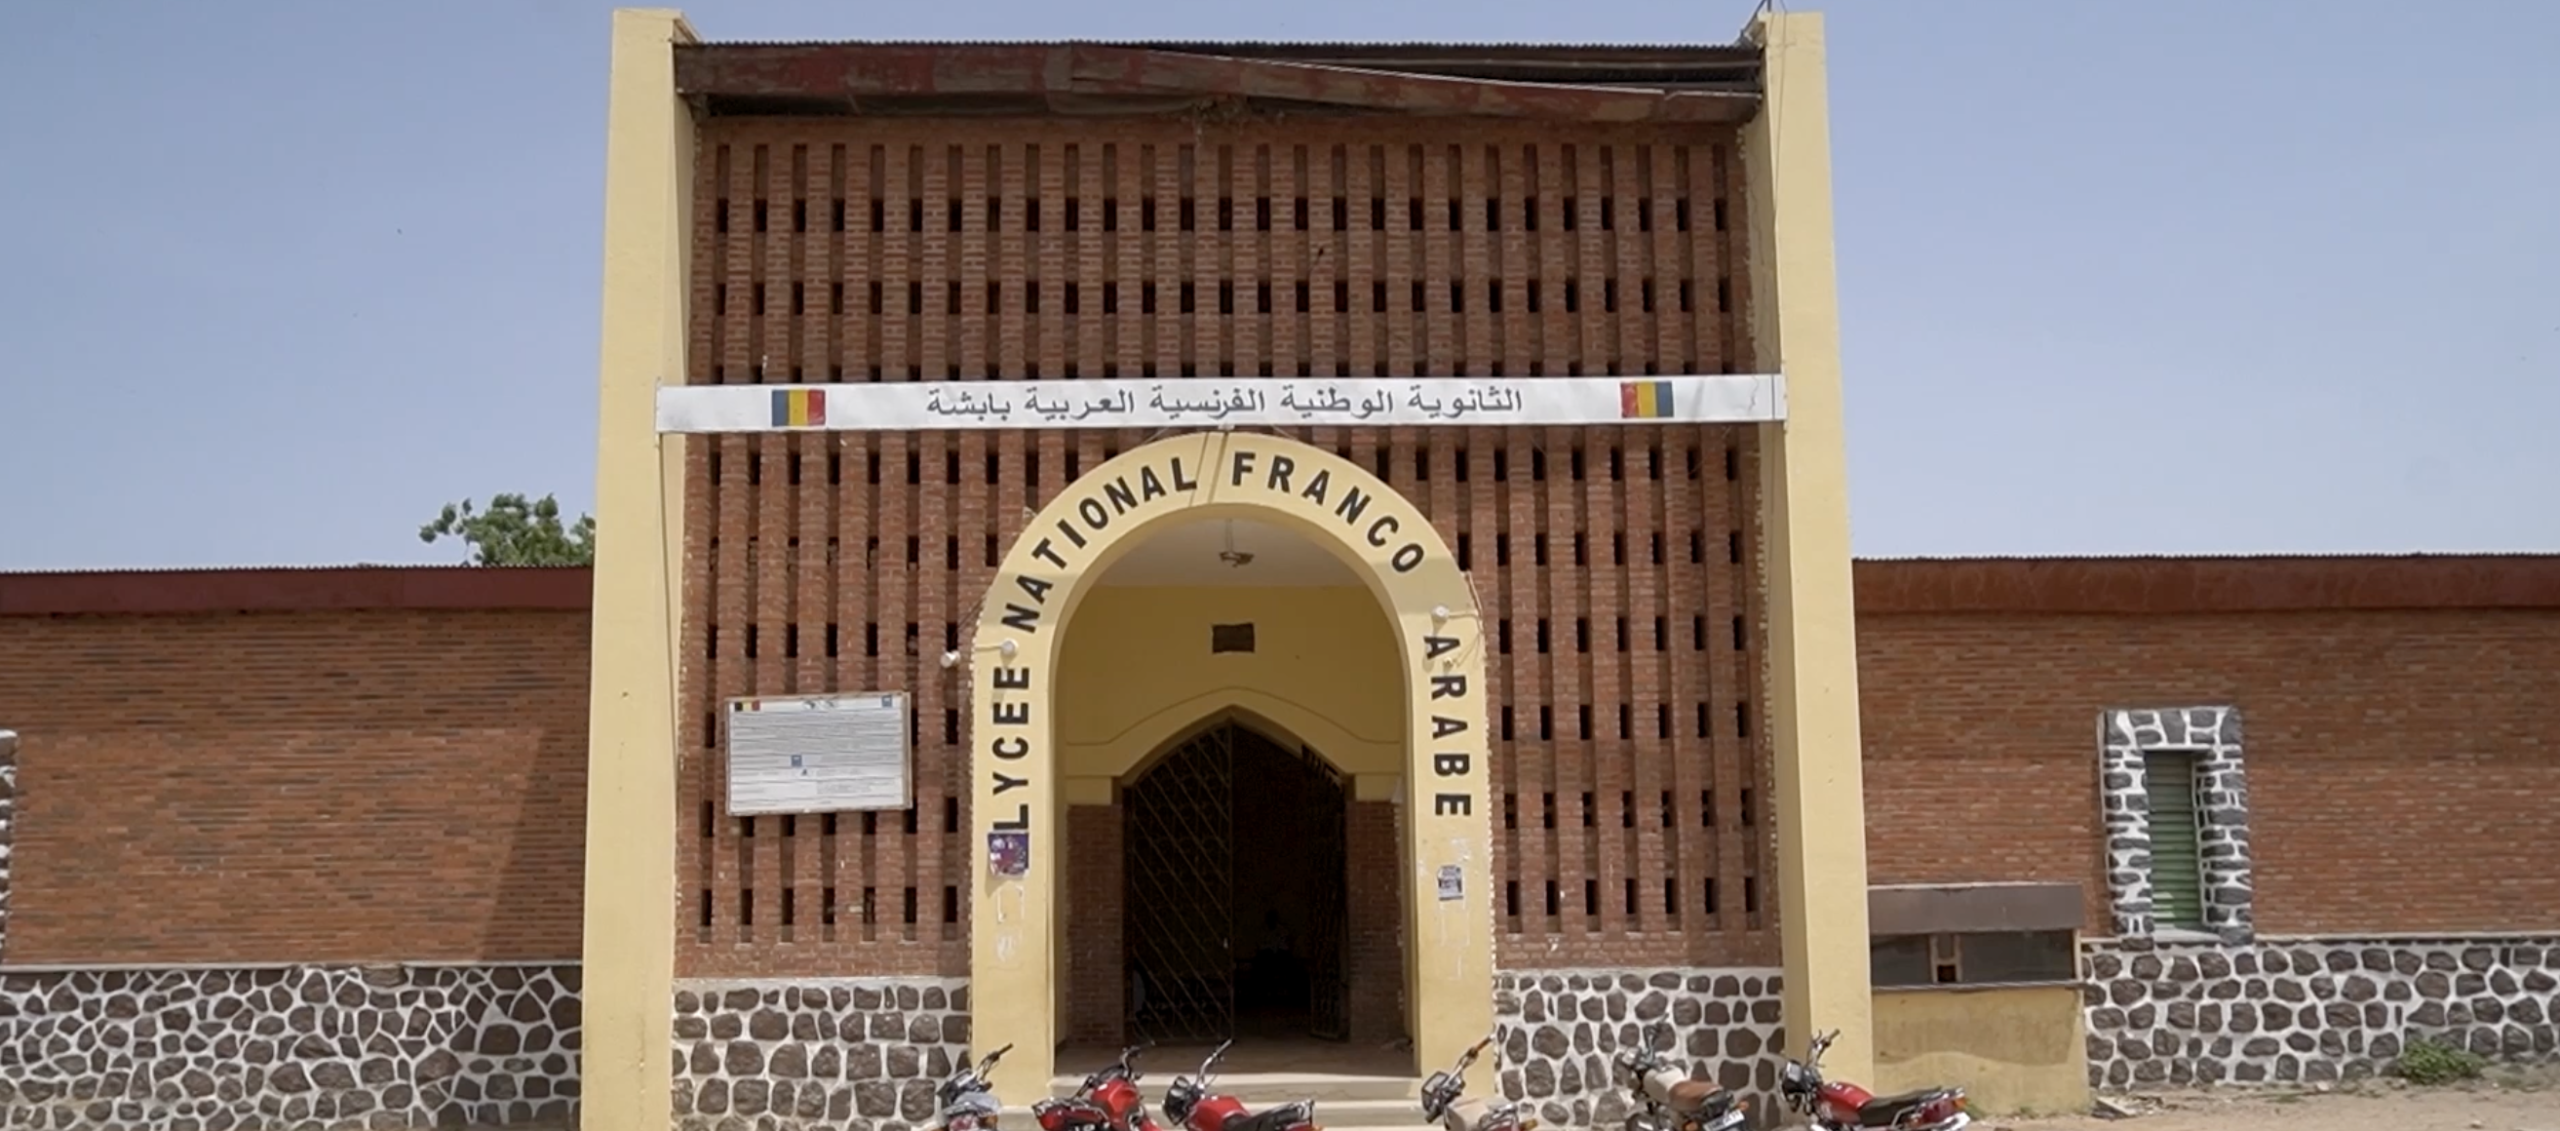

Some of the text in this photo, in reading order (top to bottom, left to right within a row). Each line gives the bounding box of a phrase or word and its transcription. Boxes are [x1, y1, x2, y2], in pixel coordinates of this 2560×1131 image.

[927, 385, 1522, 421] الثانوية الوطنية الفرنسية العربية بابشة
[1001, 456, 1197, 633] NATIONAL
[1232, 451, 1424, 574] FRANCO
[992, 666, 1030, 830] LYCEE
[1423, 634, 1472, 817] ARABE
